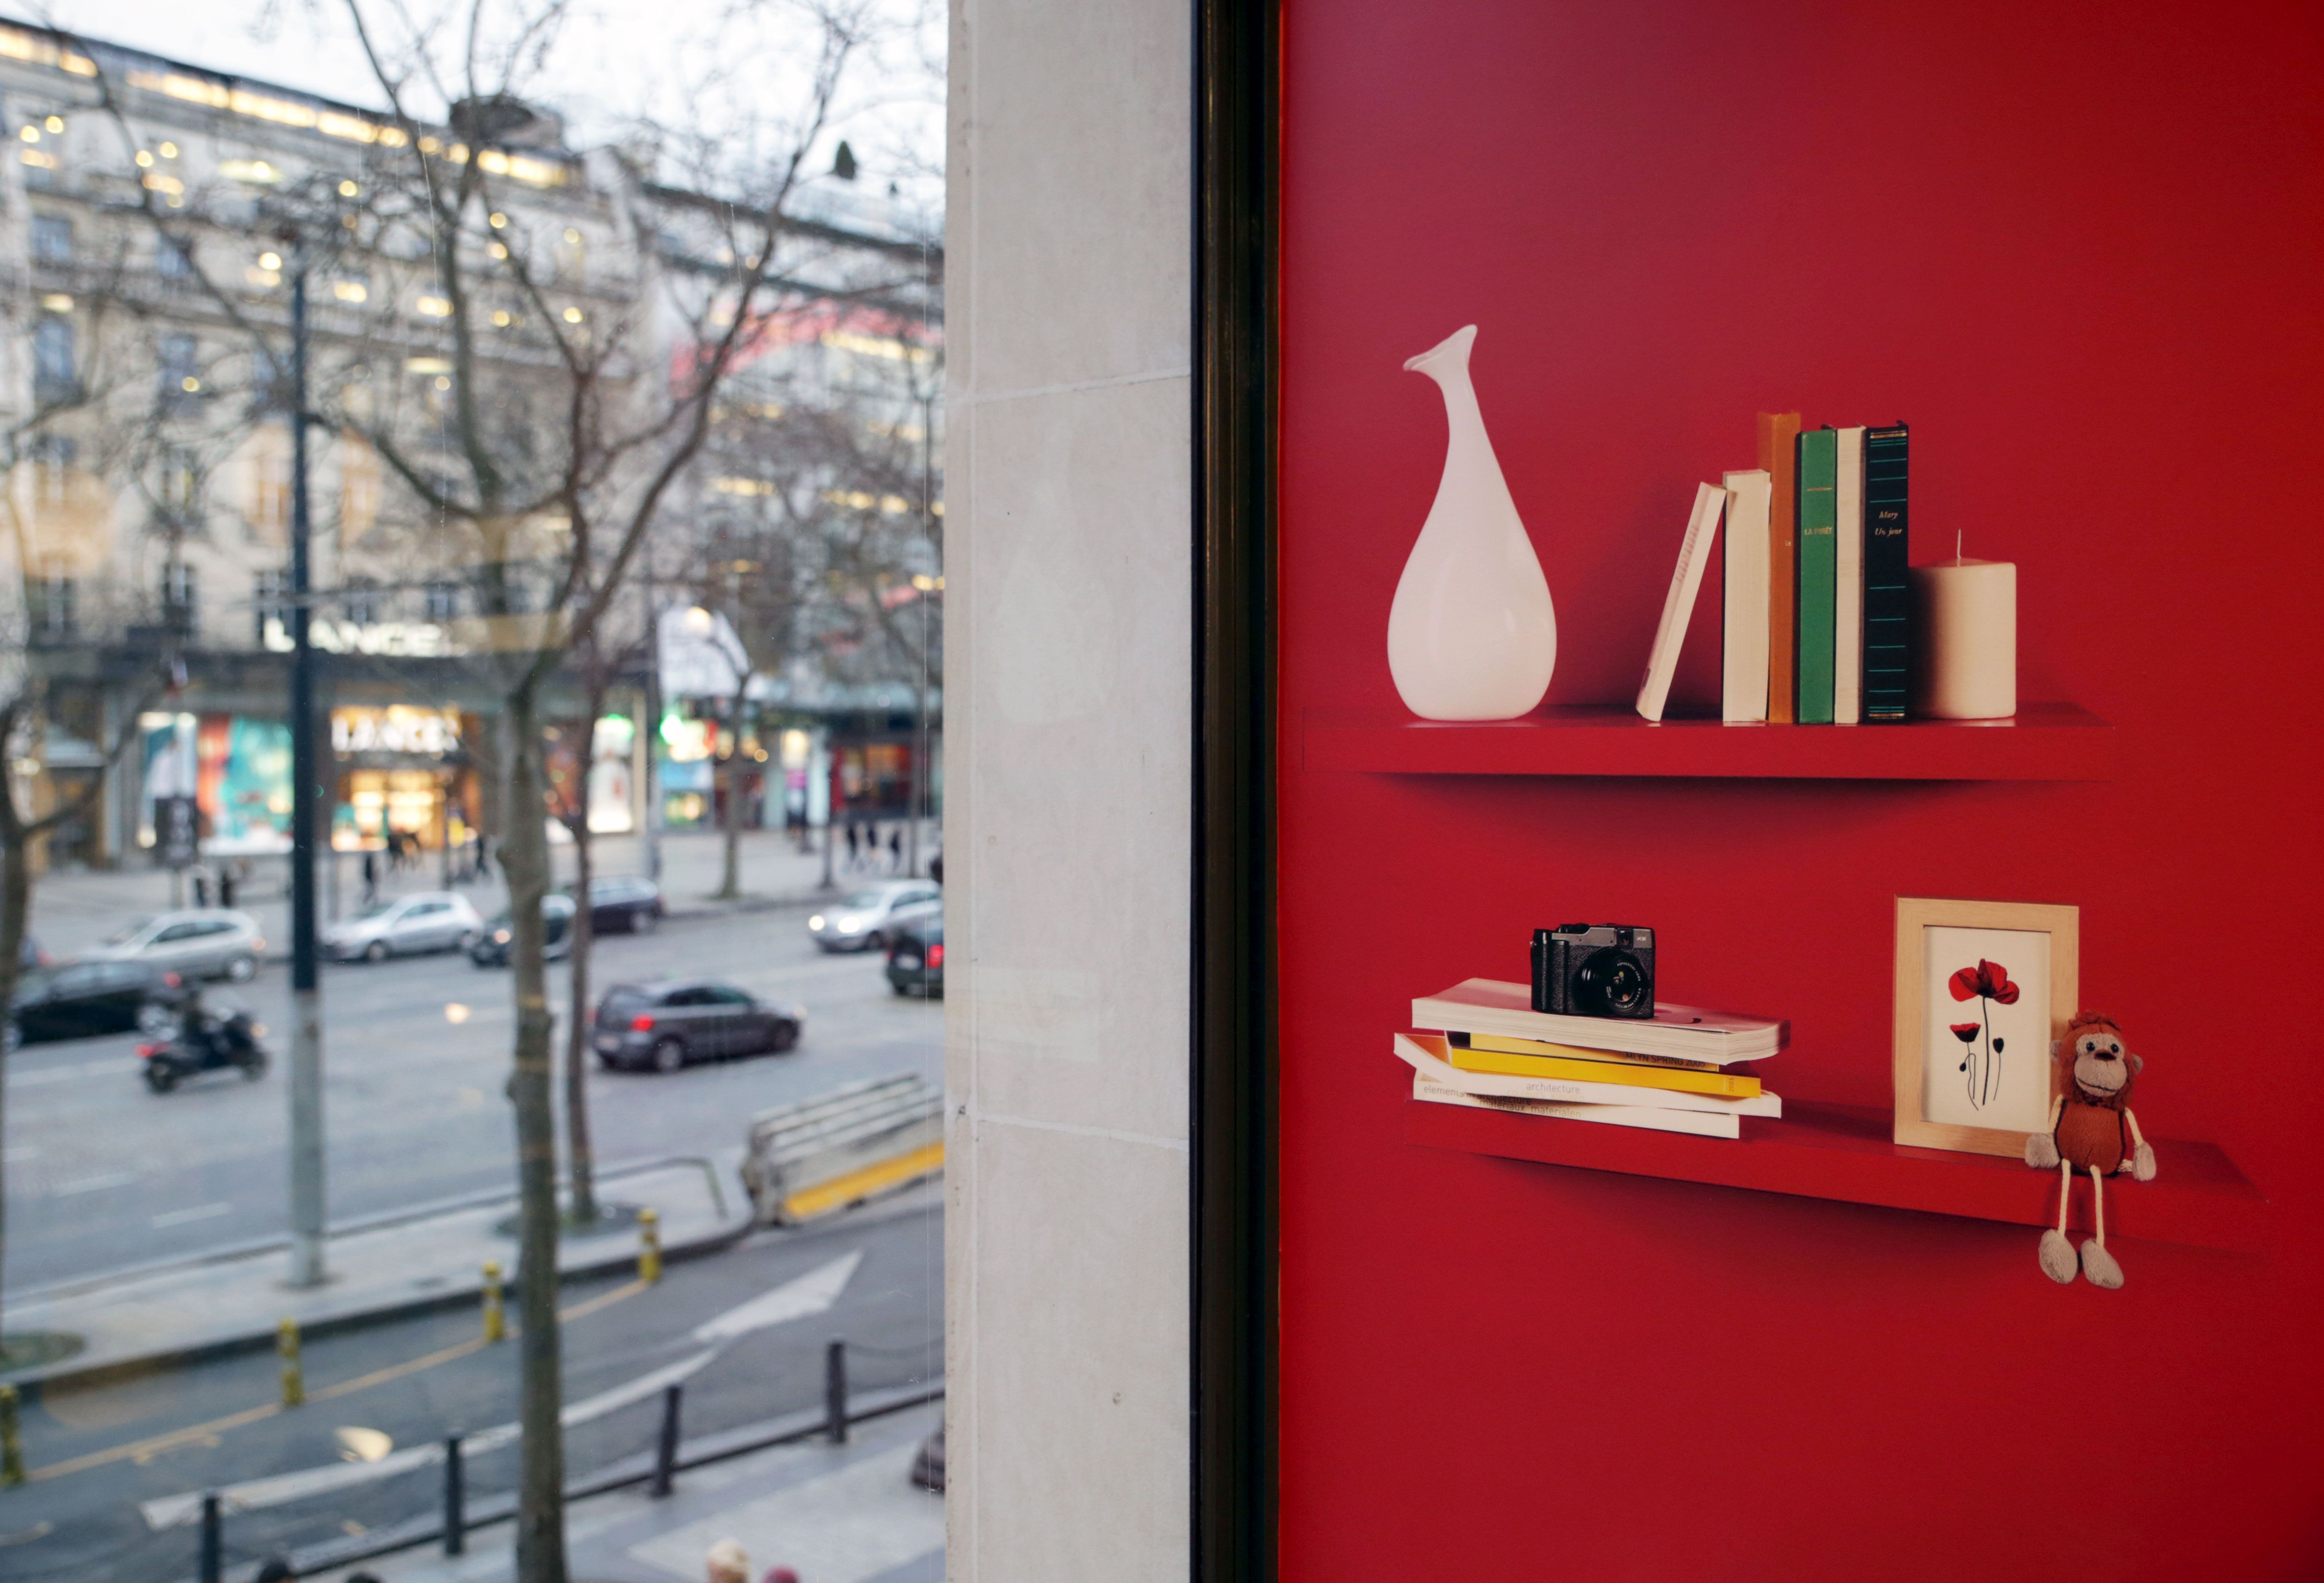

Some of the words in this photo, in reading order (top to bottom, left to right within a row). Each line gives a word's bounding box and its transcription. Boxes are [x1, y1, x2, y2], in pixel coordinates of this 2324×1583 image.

[1879, 511, 1898, 521] Mary
[1887, 527, 1902, 537] jour
[1651, 1055, 1684, 1066] SPRING
[1423, 1084, 1464, 1097] elements
[1526, 1083, 1580, 1094] architecture
[1531, 1105, 1581, 1118] materialen
